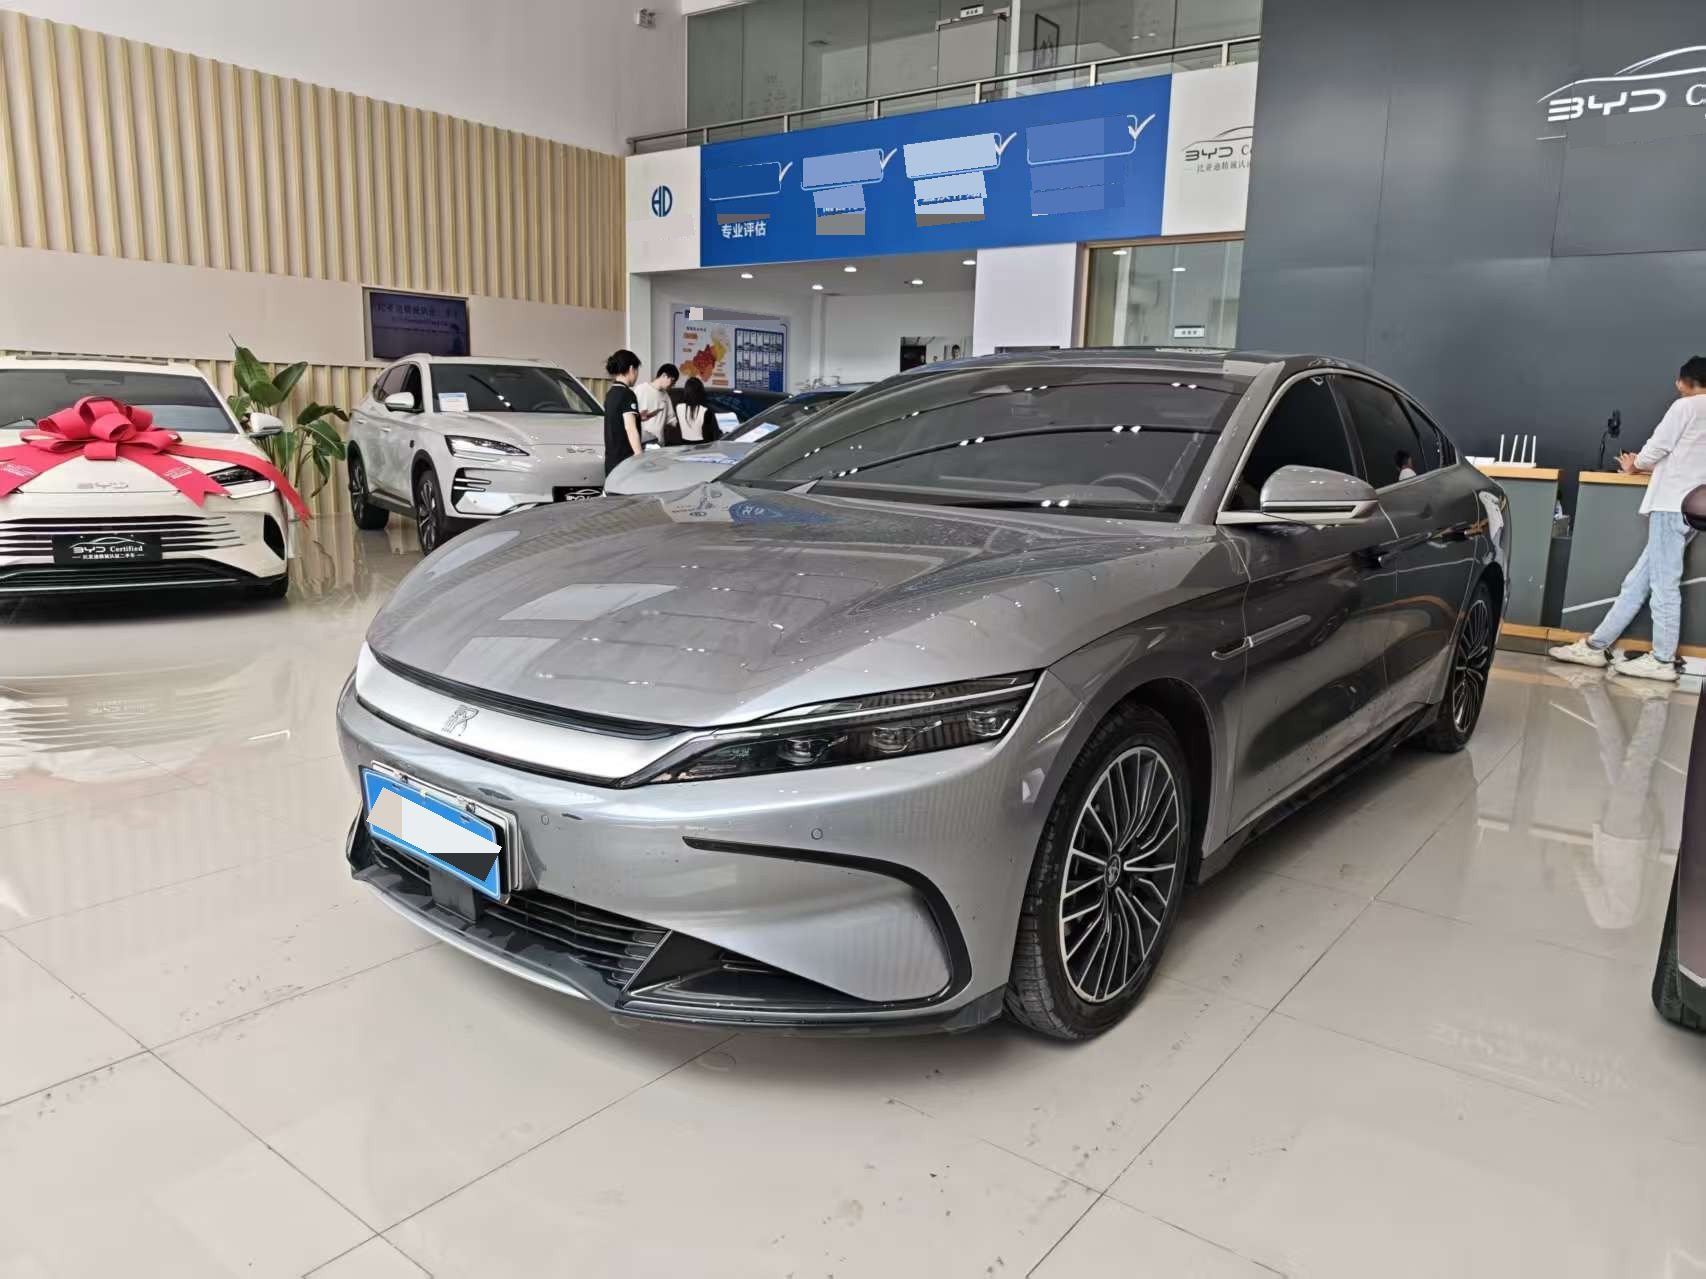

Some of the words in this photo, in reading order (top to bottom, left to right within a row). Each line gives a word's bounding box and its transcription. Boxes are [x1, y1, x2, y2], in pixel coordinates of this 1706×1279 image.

[1548, 88, 1667, 122] BYD
[1185, 146, 1233, 161] BYD
[720, 220, 767, 239] 专业评估
